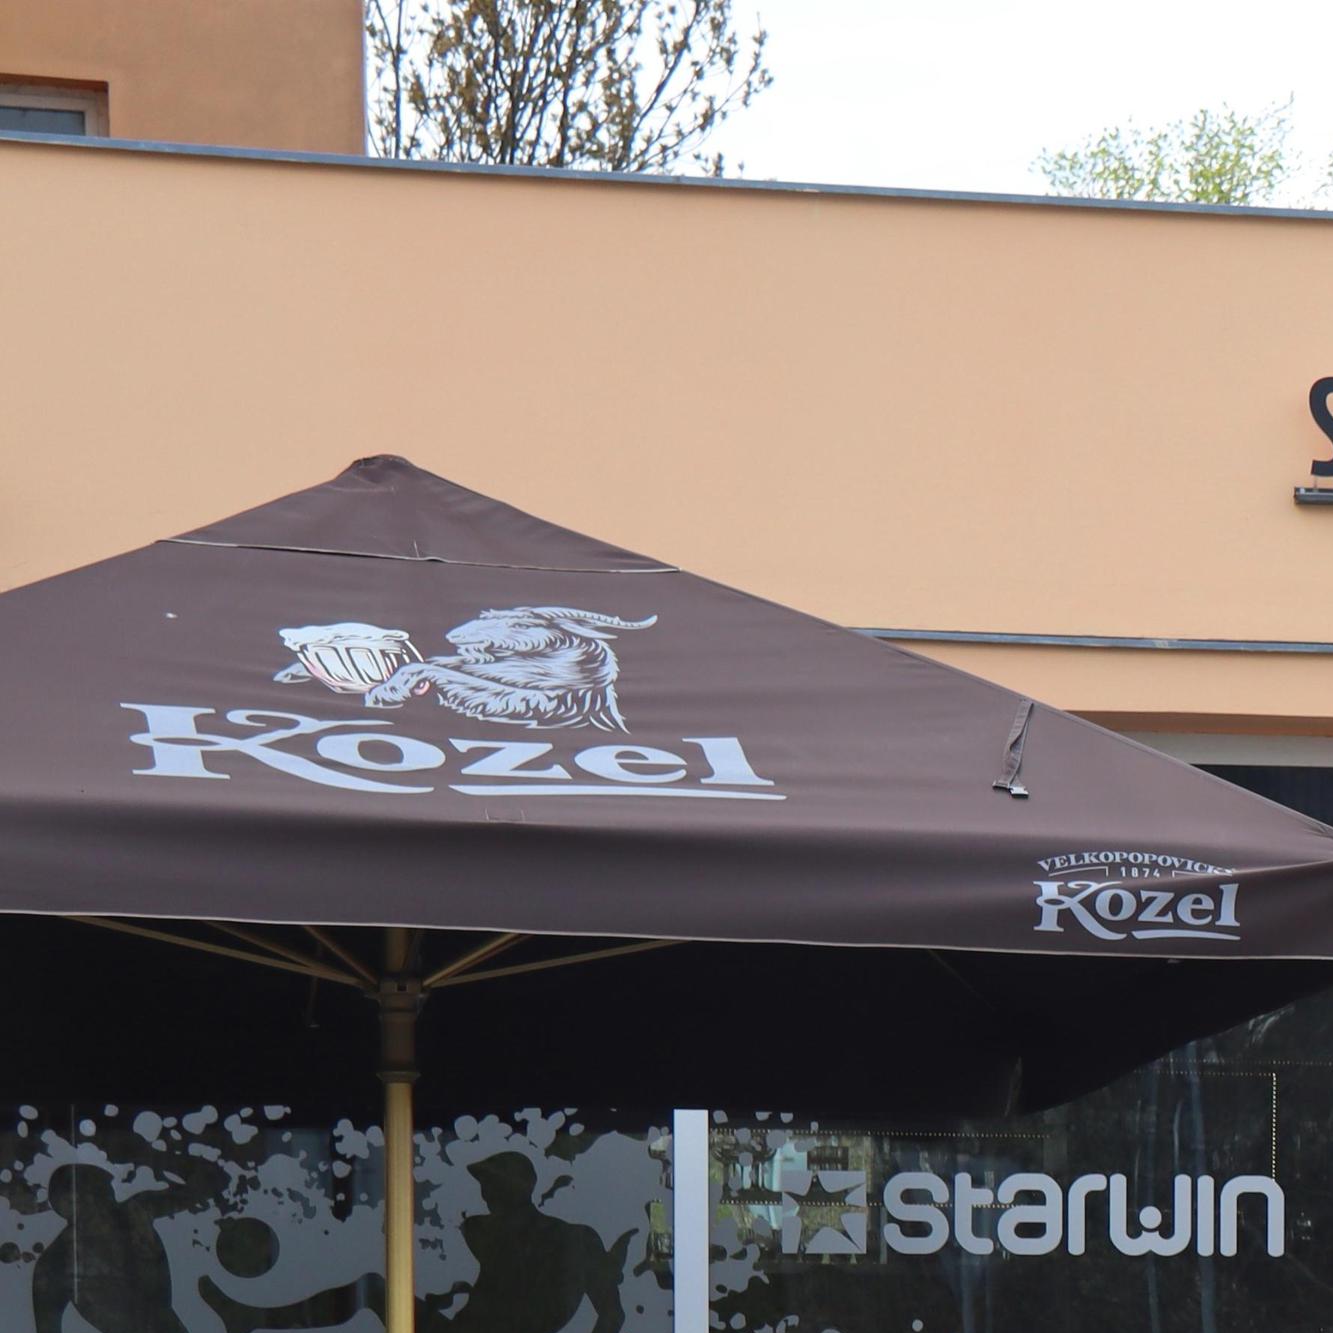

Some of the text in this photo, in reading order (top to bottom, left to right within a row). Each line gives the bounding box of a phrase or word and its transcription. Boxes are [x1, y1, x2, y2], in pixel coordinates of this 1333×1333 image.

[120, 702, 777, 795] Kozel
[1120, 866, 1161, 878] 1874
[1033, 880, 1241, 940] Kozel
[883, 1172, 1286, 1257] starwin
